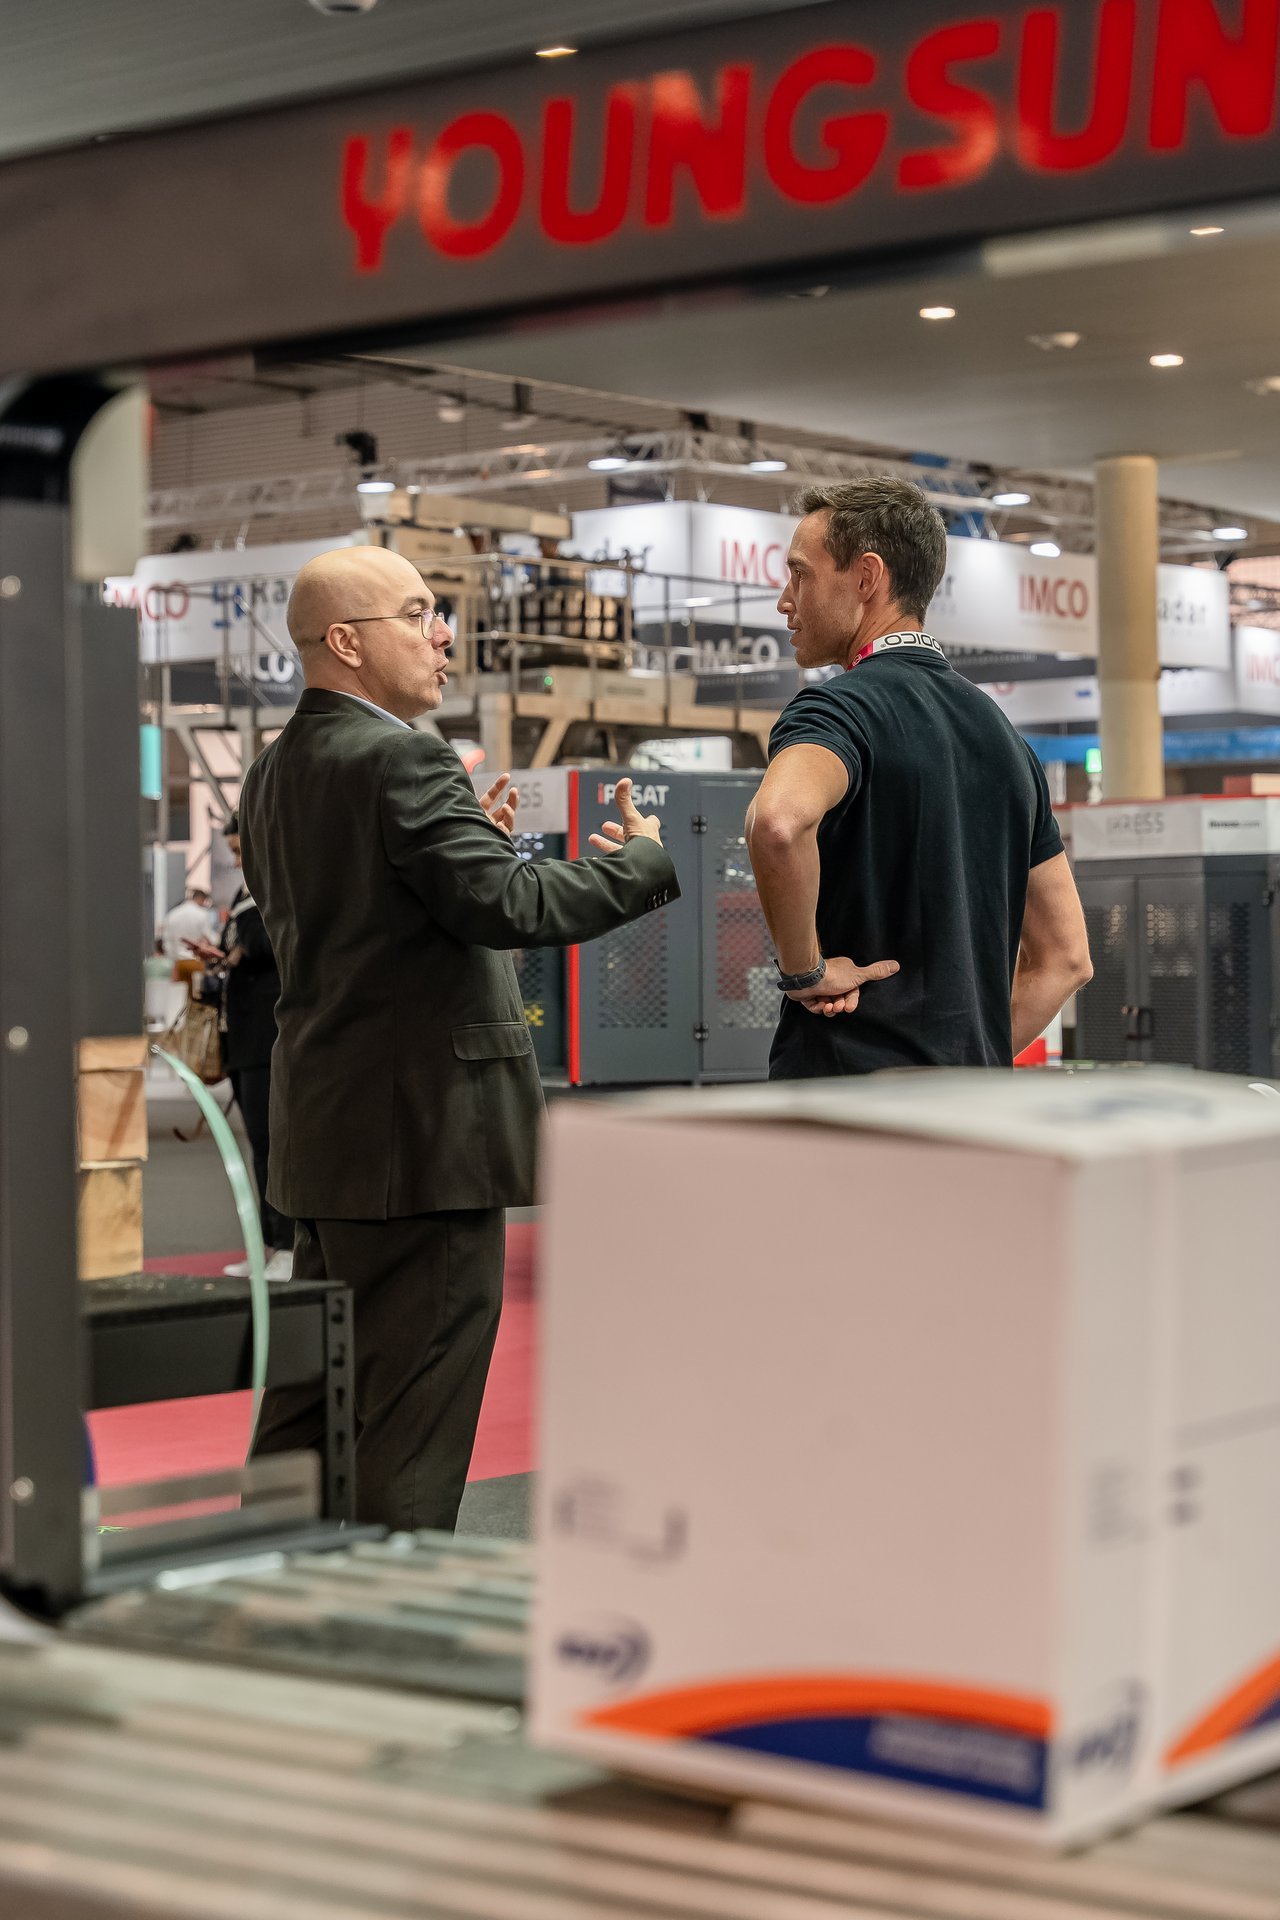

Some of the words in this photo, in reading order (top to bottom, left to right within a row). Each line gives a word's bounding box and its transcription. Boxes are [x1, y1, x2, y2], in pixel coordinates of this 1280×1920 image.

[338, 0, 1280, 273] YOUNGSUN
[720, 539, 790, 588] IMC
[1019, 574, 1089, 620] IMCO
[598, 782, 670, 807] iPSAT
